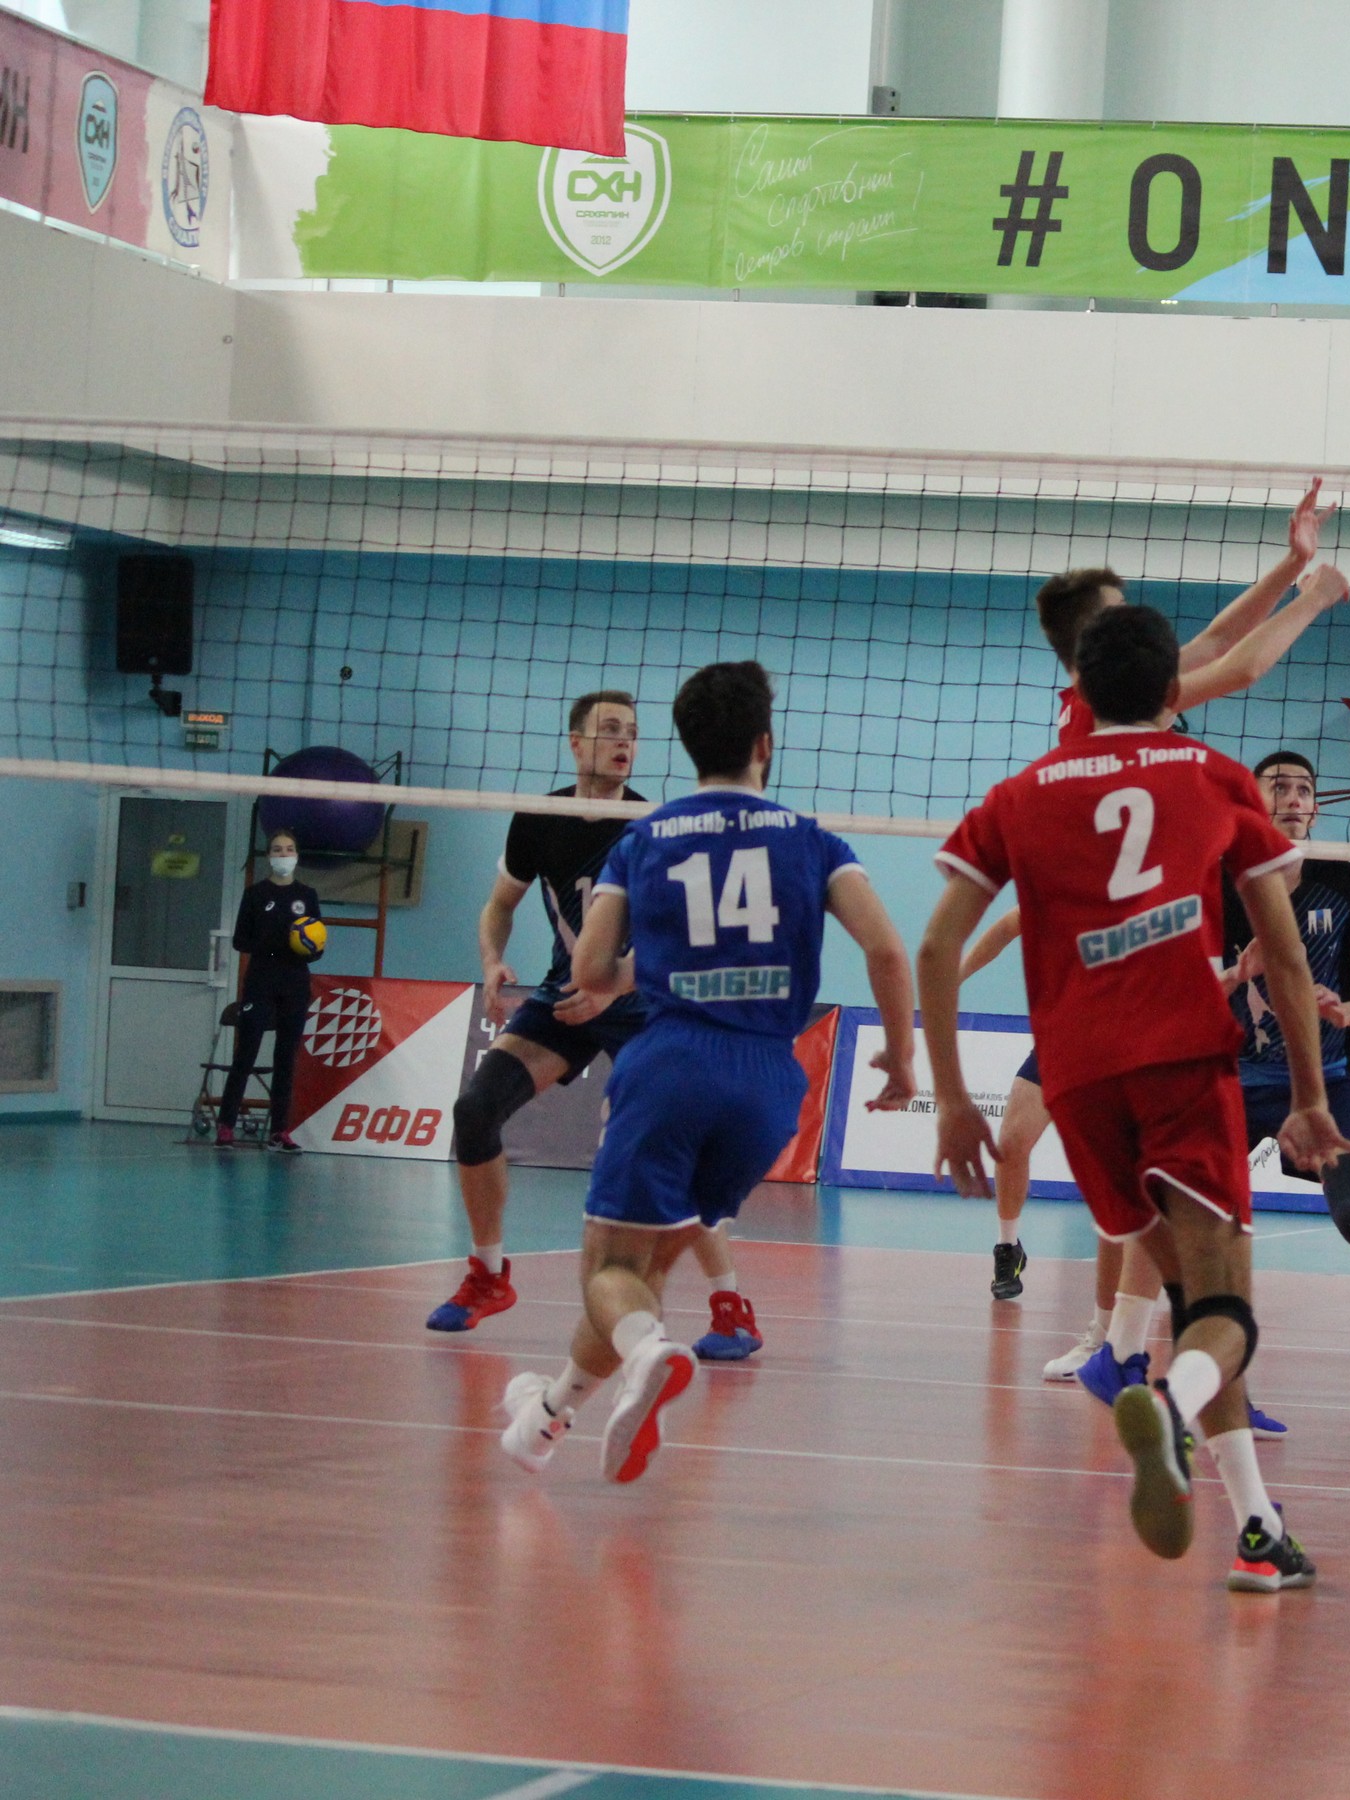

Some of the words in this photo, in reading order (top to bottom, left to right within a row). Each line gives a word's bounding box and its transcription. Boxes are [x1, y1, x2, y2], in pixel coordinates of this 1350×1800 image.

[590, 235, 612, 245] 2012
[1094, 787, 1163, 900] 2
[667, 846, 779, 947] 14
[1080, 900, 1199, 965] СИБУР
[673, 969, 790, 998] СИБУР
[331, 1103, 442, 1146] ВФВ
